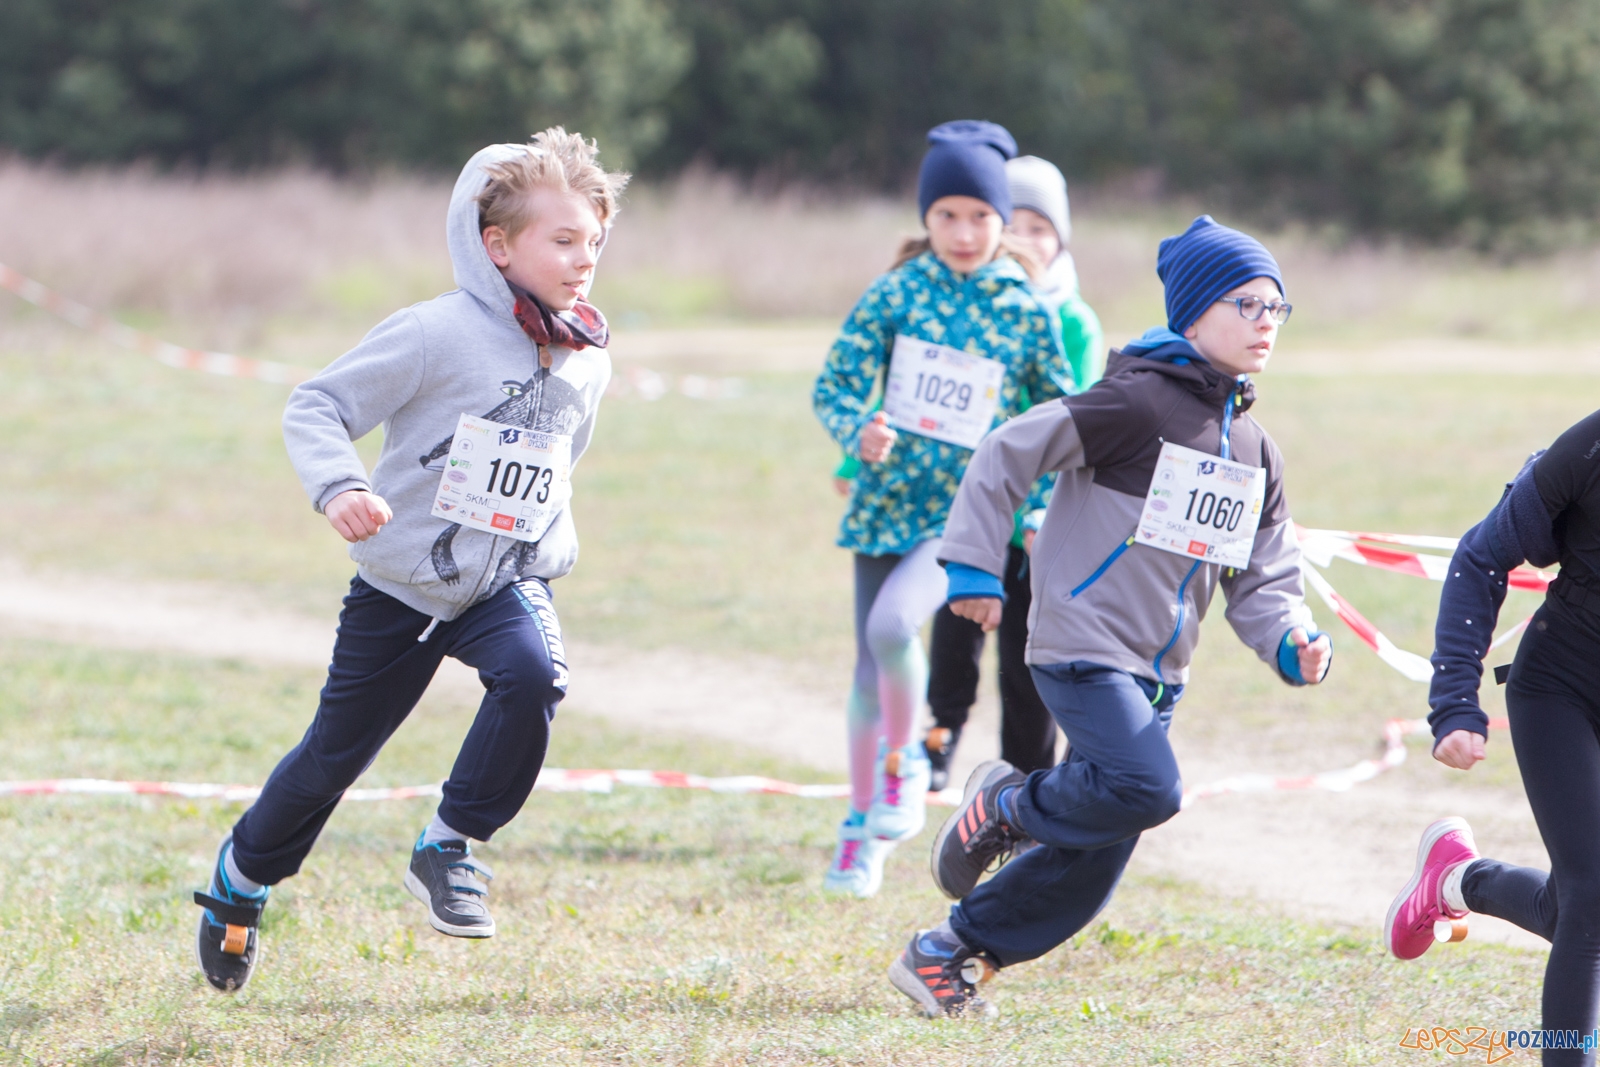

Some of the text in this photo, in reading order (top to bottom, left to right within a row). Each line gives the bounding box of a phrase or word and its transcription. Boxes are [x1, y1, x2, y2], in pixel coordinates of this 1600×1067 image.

[914, 372, 972, 411] 1029
[465, 493, 488, 507] 5KM
[486, 457, 553, 504] 1073
[1185, 487, 1244, 532] 1060
